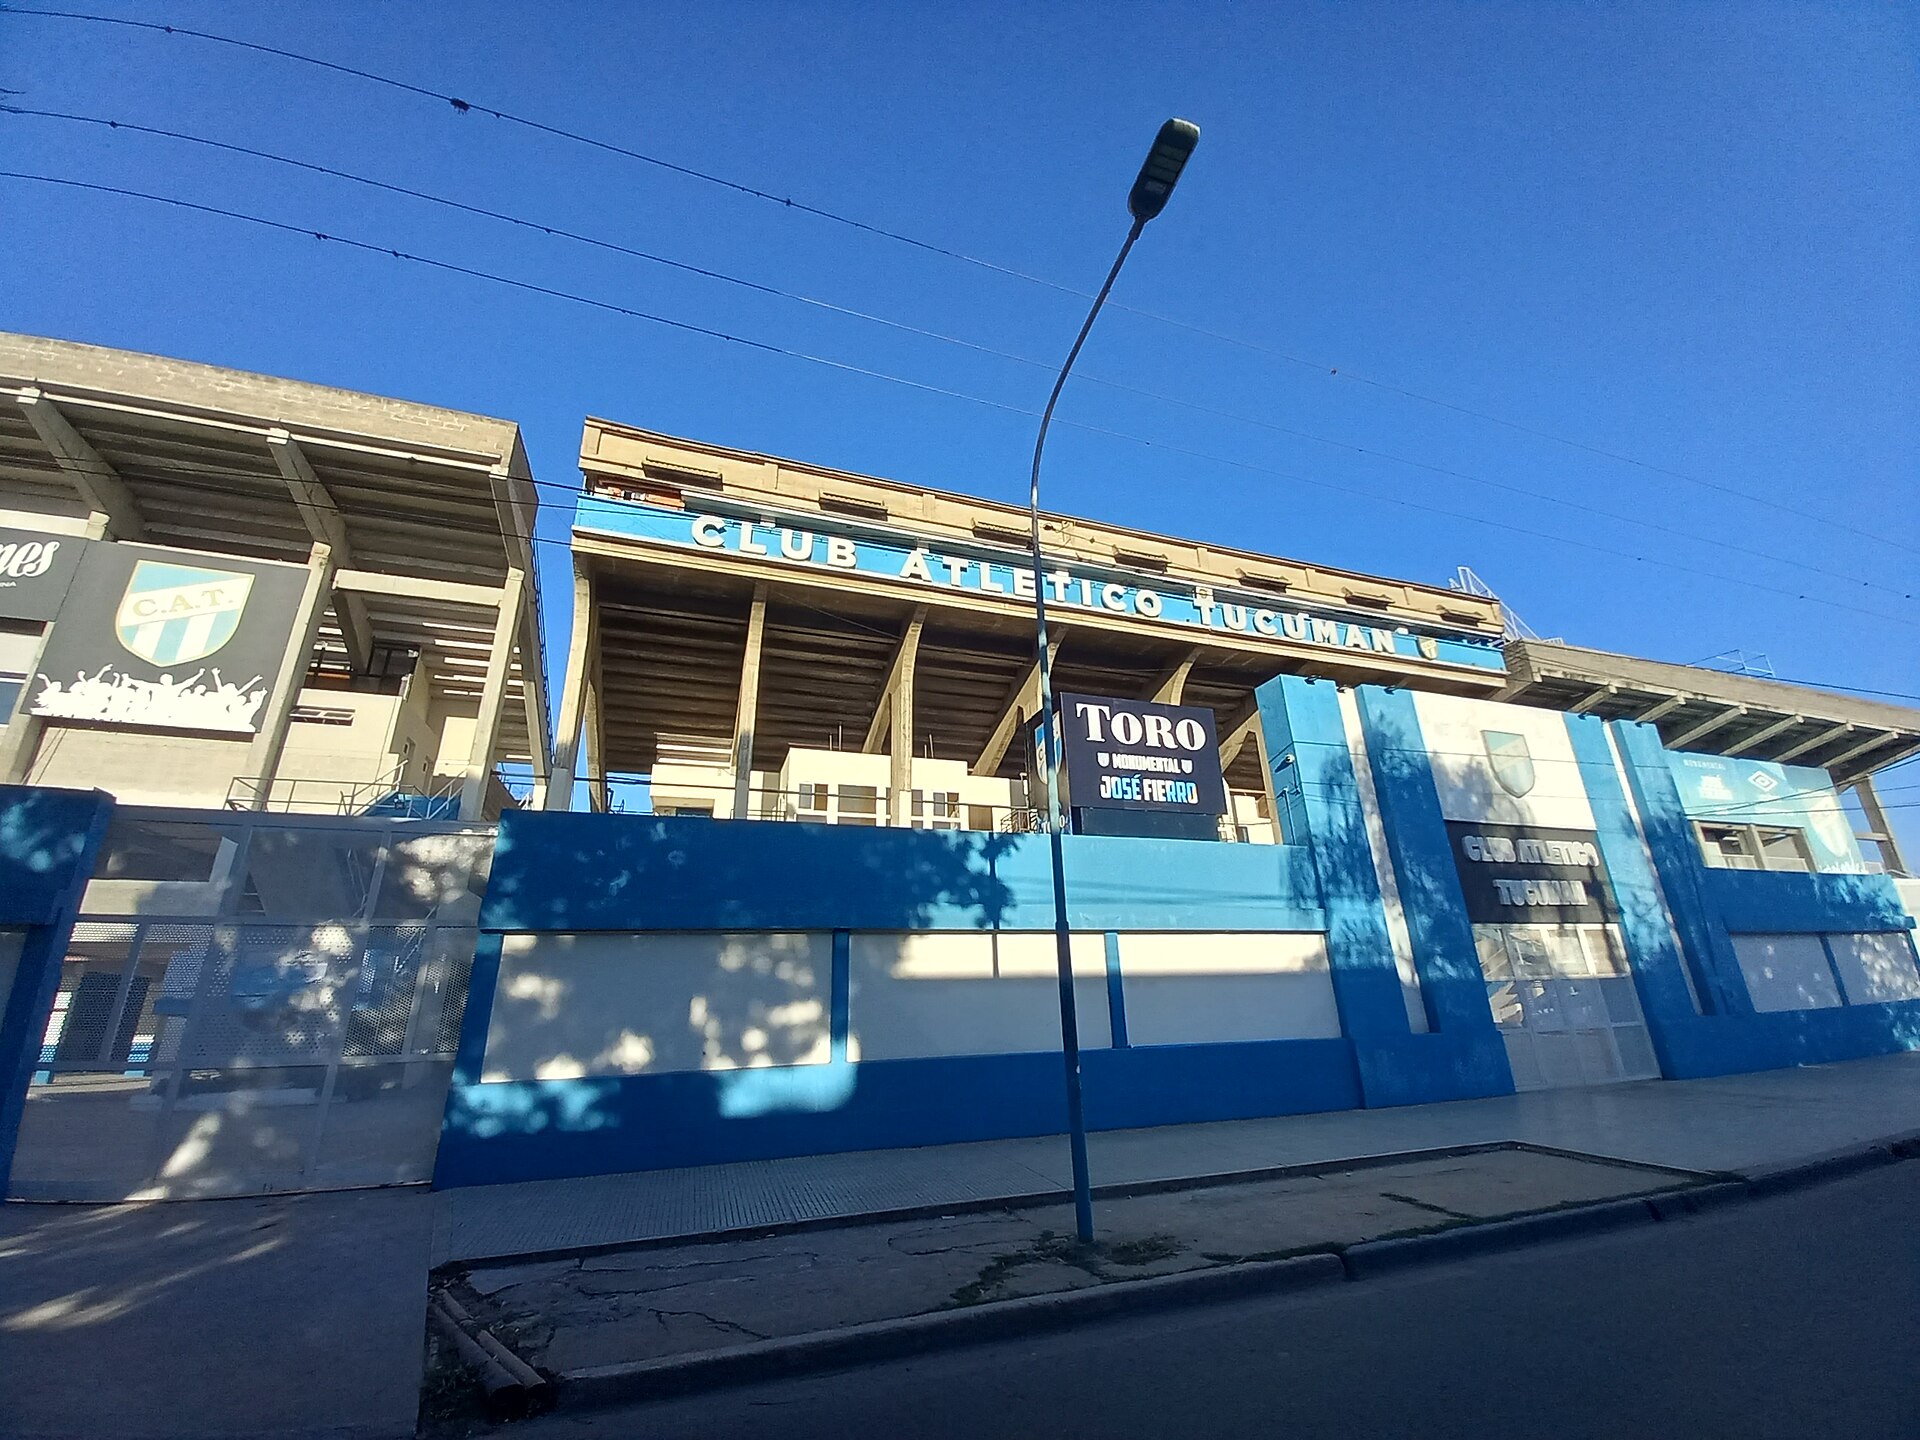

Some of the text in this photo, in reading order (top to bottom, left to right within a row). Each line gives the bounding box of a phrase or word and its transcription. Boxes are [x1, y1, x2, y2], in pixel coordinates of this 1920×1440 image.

[691, 515, 1395, 654] CLUB ATLETICO TUCUMAN
[1075, 702, 1207, 751] TORO
[1111, 752, 1181, 774] MONUMENTAL
[1099, 773, 1199, 804] JOSÉ FIERRO
[1461, 835, 1600, 867] CLUB ATLETICO
[1492, 879, 1589, 906] TUCUMAN
